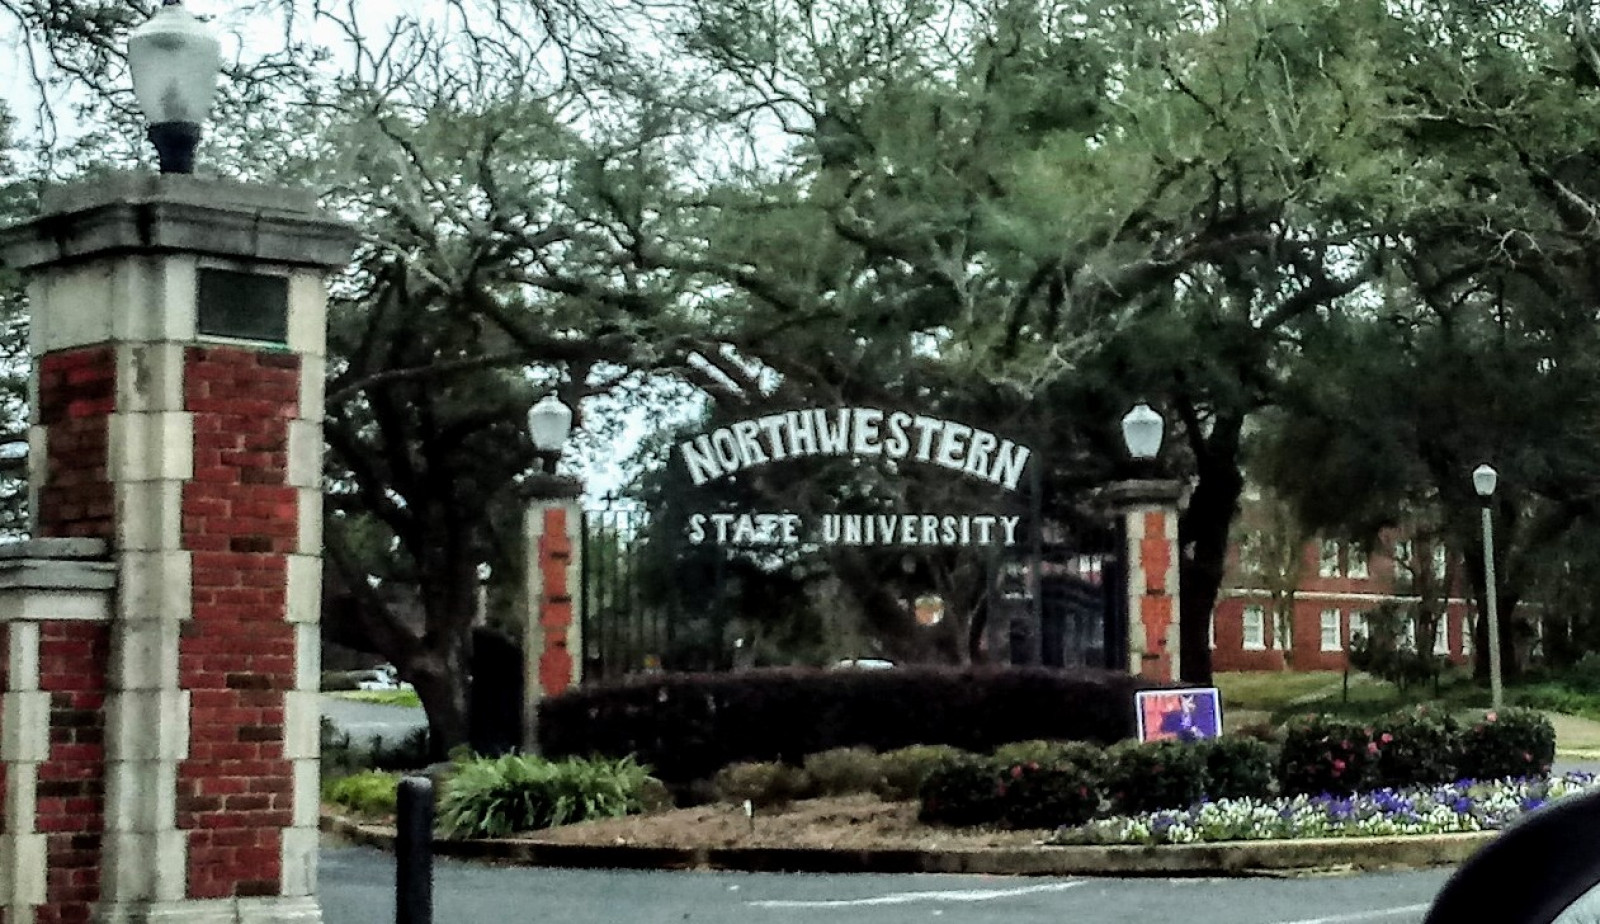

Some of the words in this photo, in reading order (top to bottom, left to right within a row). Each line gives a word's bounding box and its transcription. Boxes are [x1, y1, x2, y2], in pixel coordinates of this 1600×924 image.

[681, 407, 1031, 490] NORTHWESTERN
[689, 513, 800, 544] STATE
[822, 514, 1020, 545] UNIVERSITY
